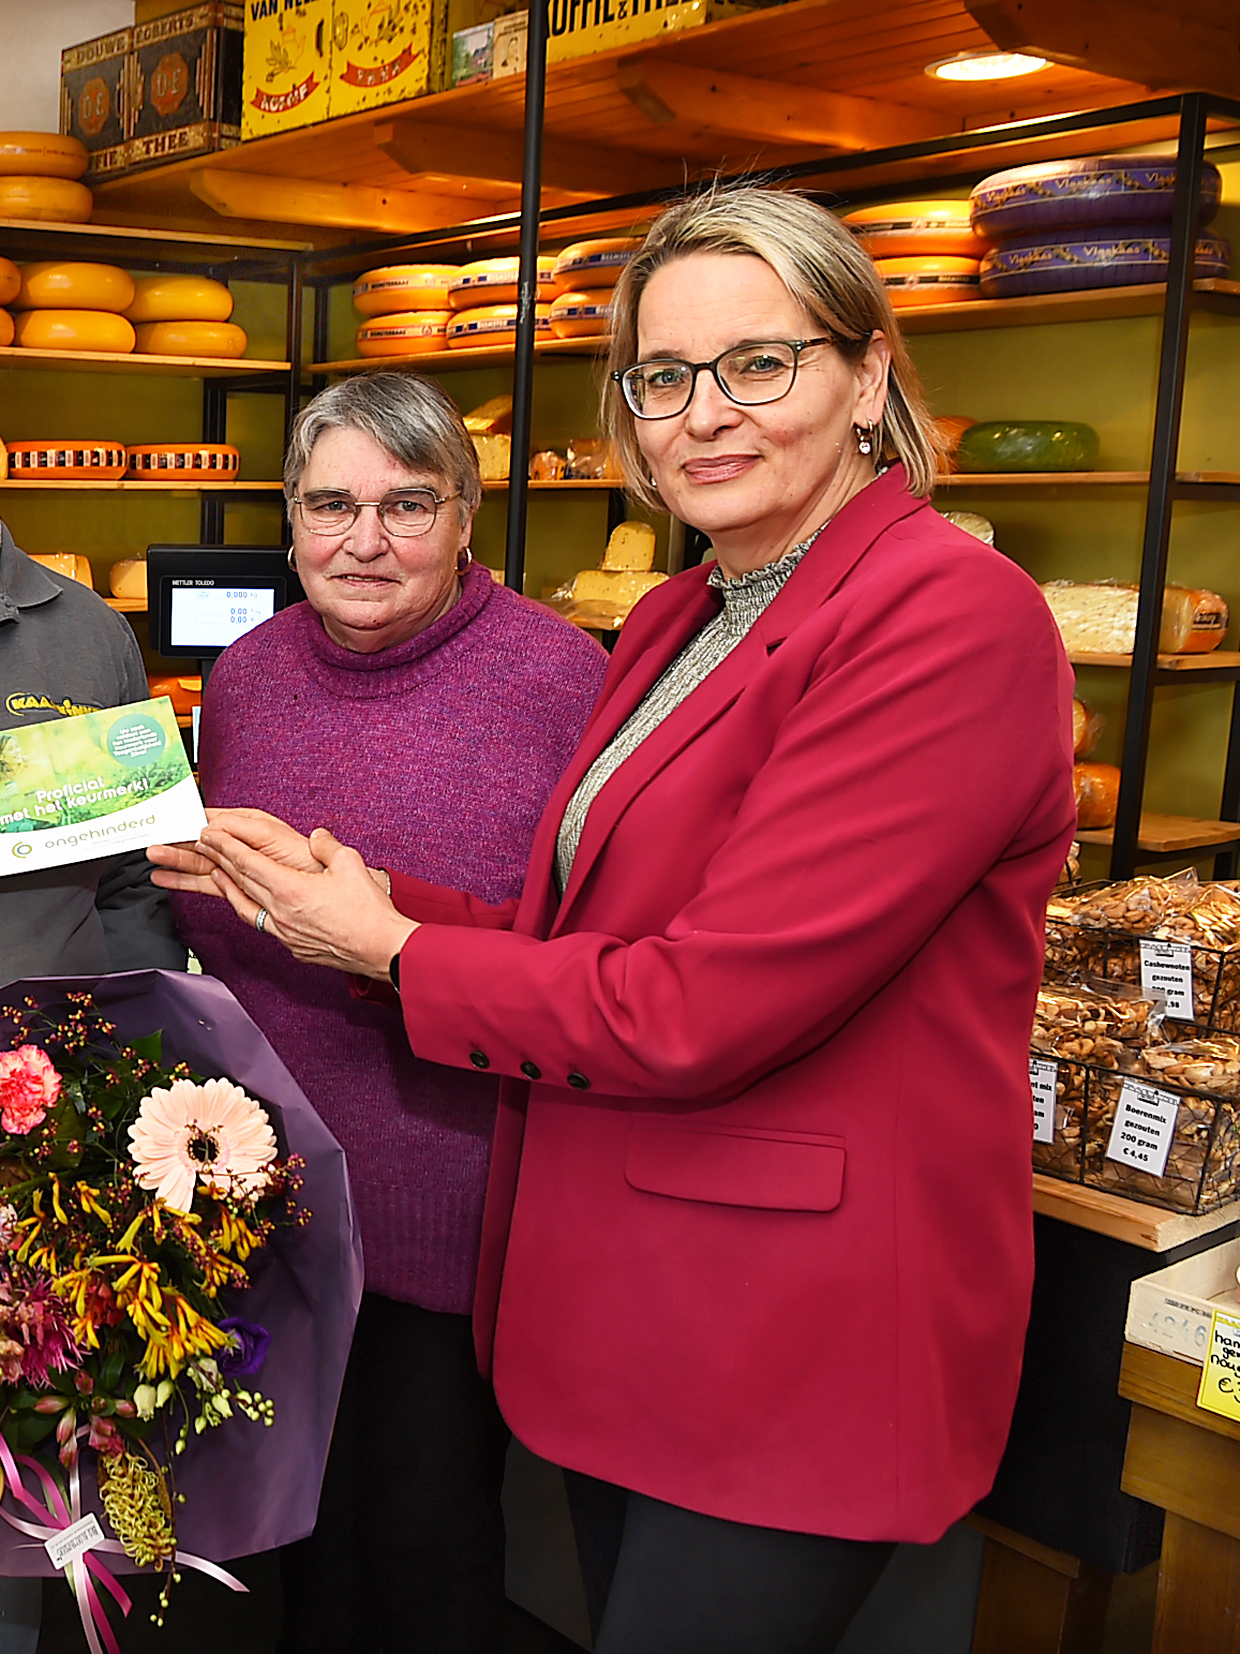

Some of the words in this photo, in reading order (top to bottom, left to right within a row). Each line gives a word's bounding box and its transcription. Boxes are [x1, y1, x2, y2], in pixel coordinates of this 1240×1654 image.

[36, 776, 105, 803] Proficiat
[0, 807, 31, 826] met
[34, 799, 63, 817] het
[66, 777, 150, 811] keurmerk!
[44, 814, 156, 849] ongehinderd
[1144, 960, 1191, 971] Cashewnoten
[1166, 988, 1185, 996] gram
[1039, 1082, 1053, 1092] mix
[1125, 1104, 1167, 1124] Boerenmix
[1124, 1119, 1161, 1136] gezouten
[1120, 1131, 1137, 1143] 200
[1137, 1137, 1158, 1151] gram
[1123, 1147, 1130, 1156] €
[1130, 1149, 1149, 1162] 4,45
